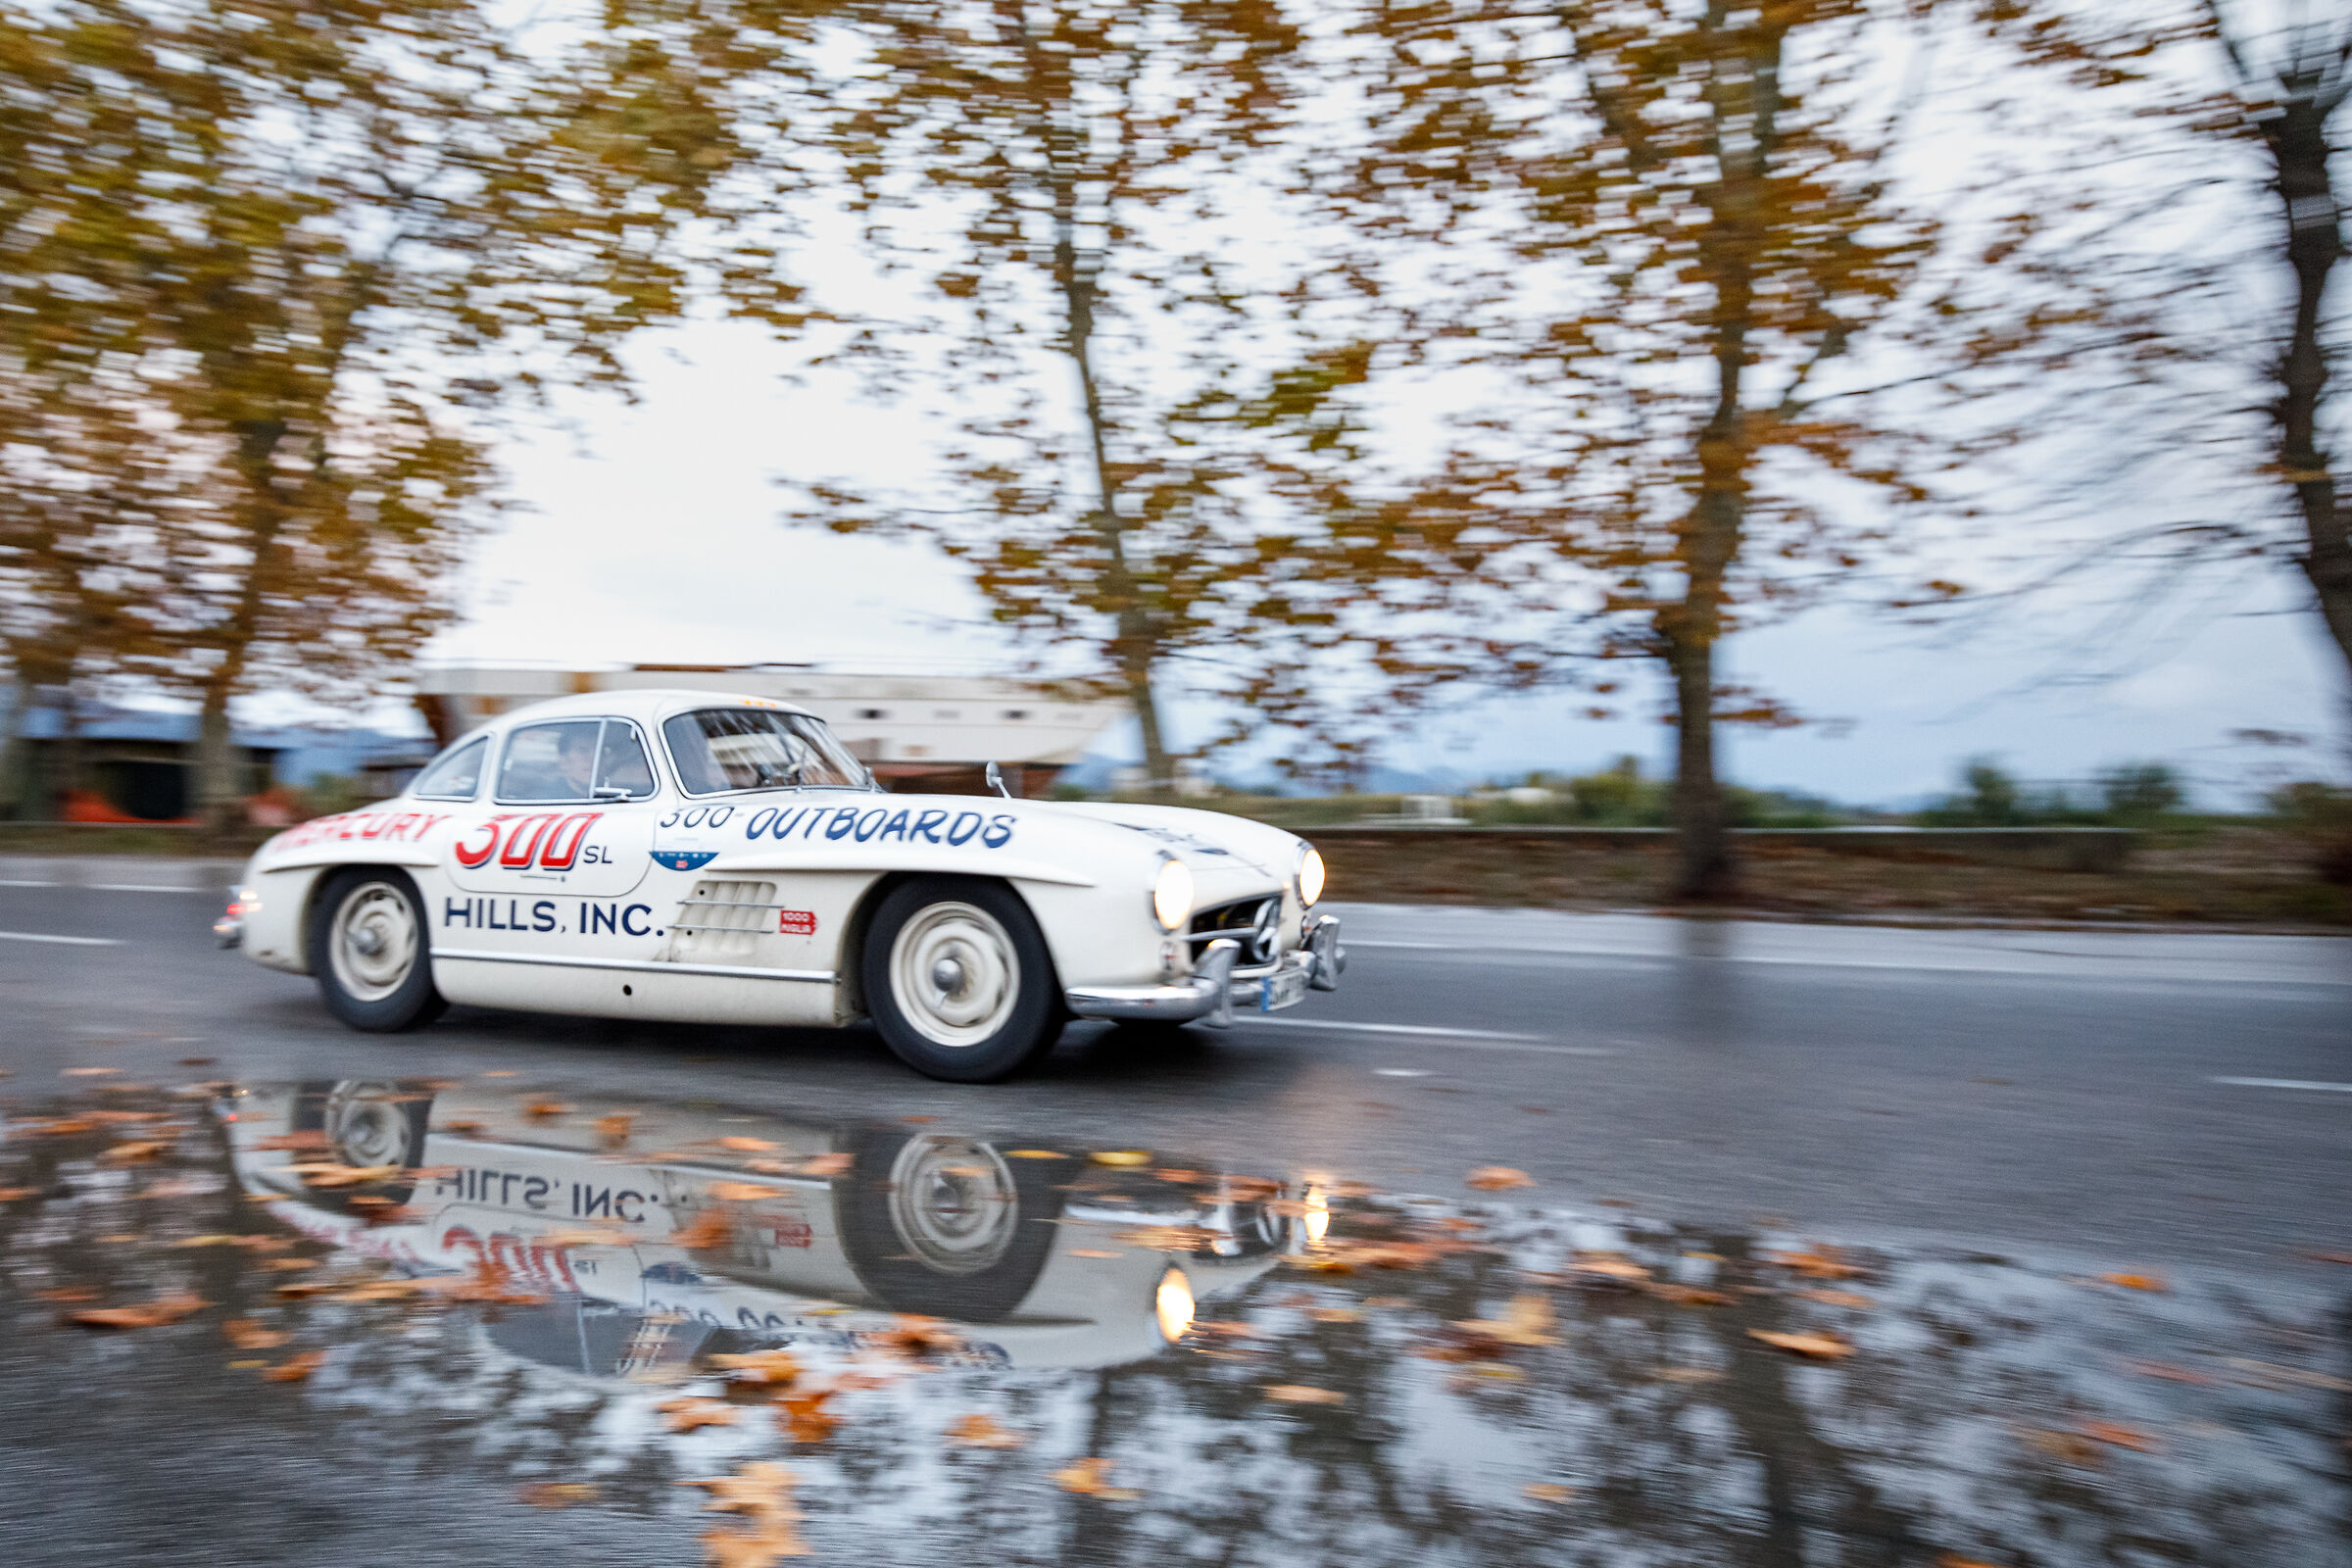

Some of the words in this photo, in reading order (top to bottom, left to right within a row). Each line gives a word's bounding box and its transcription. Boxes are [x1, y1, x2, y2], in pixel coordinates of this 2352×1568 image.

[455, 812, 605, 871] 300
[583, 846, 613, 864] SL
[746, 807, 1017, 849] OUTBOARDS
[444, 896, 566, 933] HILLS,
[579, 902, 664, 937] INC.
